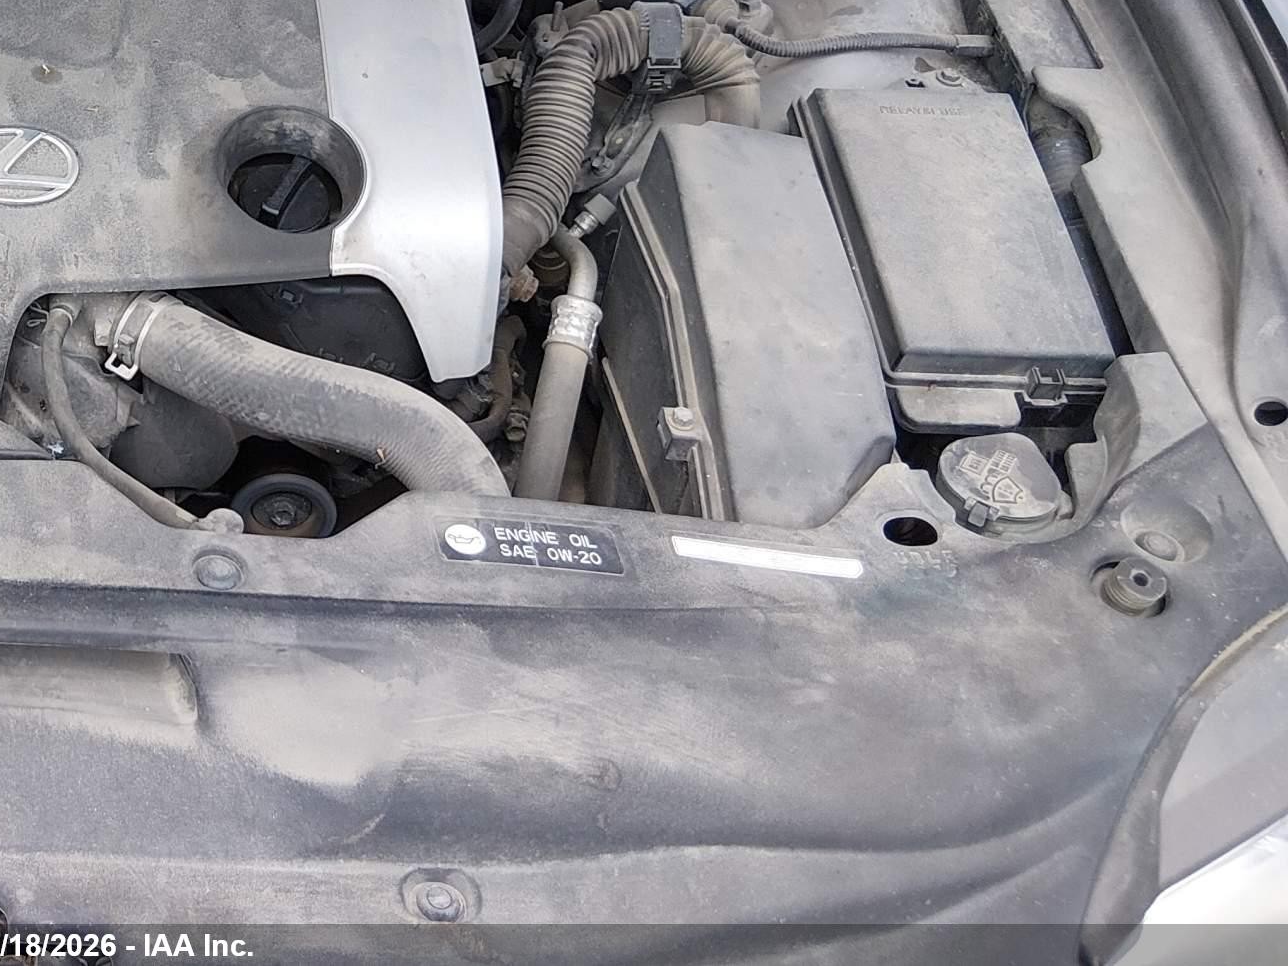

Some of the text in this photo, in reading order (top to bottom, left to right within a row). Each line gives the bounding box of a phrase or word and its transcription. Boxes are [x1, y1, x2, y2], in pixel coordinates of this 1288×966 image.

[494, 526, 598, 549] ENGINE OIL
[499, 543, 603, 566] SAE 0W-20
